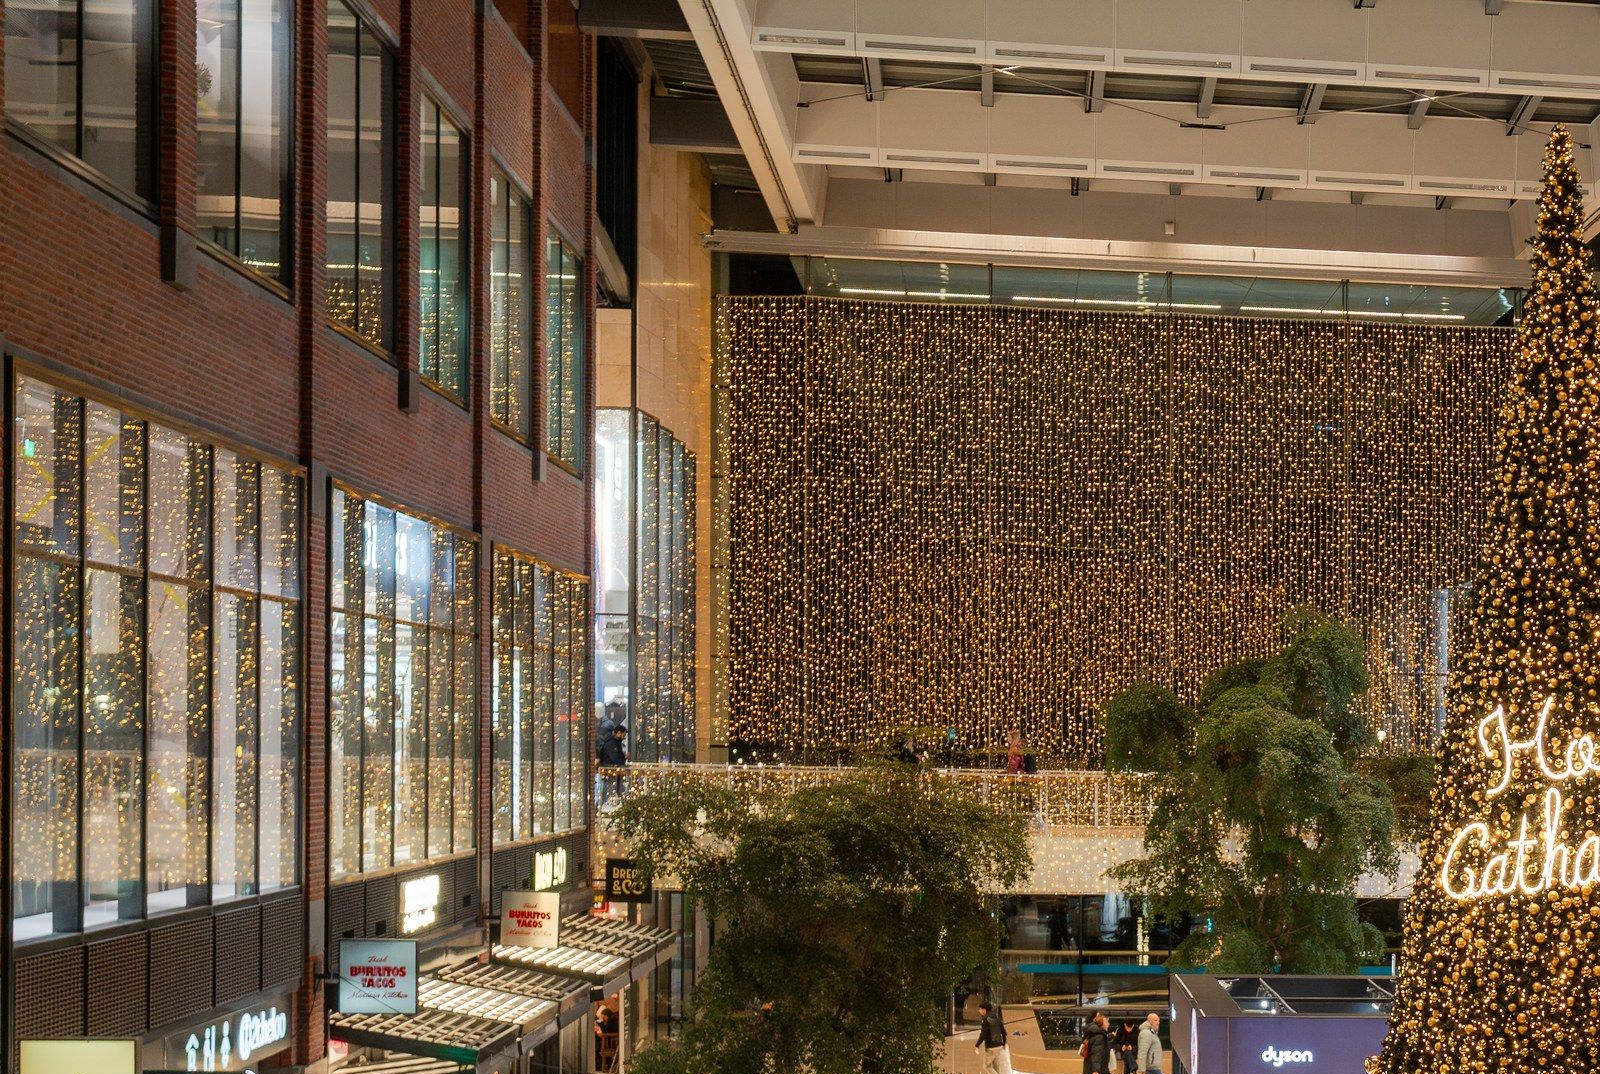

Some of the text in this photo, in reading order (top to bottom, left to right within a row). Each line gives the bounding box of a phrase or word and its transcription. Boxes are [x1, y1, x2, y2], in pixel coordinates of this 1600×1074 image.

[508, 909, 551, 920] BURRITOS
[516, 919, 543, 928] TACOS
[349, 966, 407, 977] BURRITOS
[361, 977, 396, 988] TACOS
[1261, 1045, 1314, 1067] dyson
